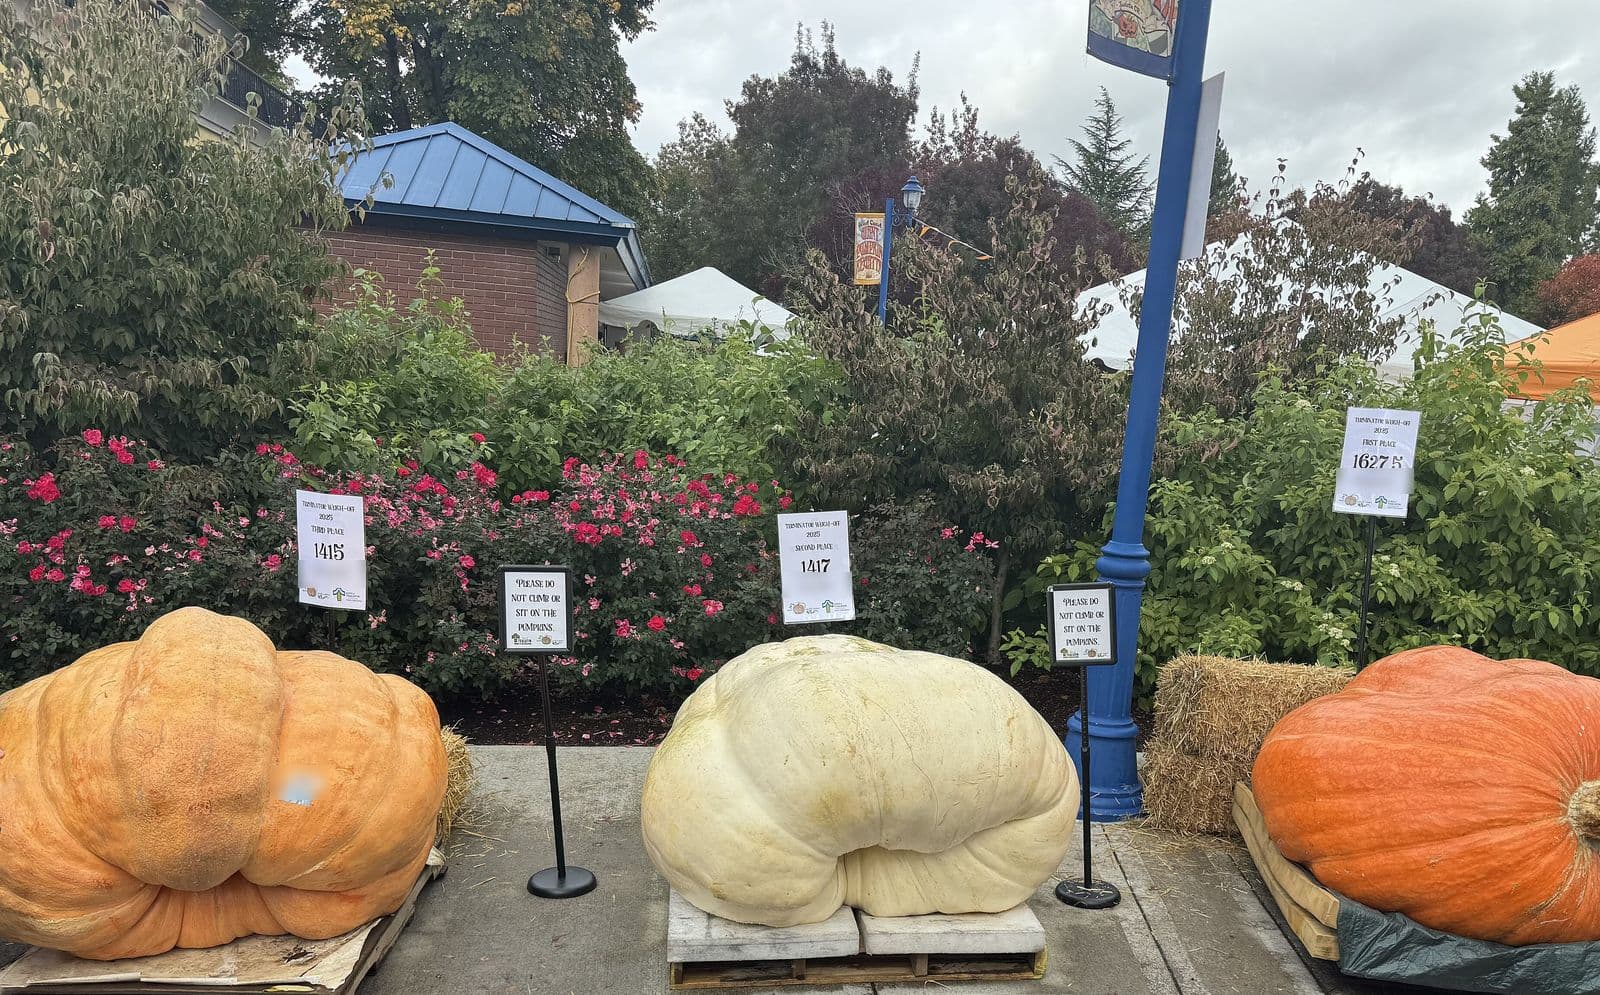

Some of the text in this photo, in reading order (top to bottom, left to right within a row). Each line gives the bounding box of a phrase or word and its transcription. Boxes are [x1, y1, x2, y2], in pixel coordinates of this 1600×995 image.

[1362, 439, 1378, 447] FIRST
[1353, 453, 1403, 469] 16275
[311, 525, 345, 536] THIRD PLACE
[314, 543, 345, 560] 1415
[817, 543, 833, 551] PLACE
[801, 559, 831, 573] 1417
[516, 579, 555, 588] PLEASE DO
[511, 594, 561, 602] NOT CLIMB OR
[1063, 597, 1099, 606] PLEASE DO
[515, 608, 557, 618] SIT ON THE
[1059, 612, 1073, 620] NOT
[1075, 611, 1094, 619] CLIMB
[1063, 624, 1101, 633] SIT ON THE
[1066, 638, 1100, 646] PUMPKINS.
